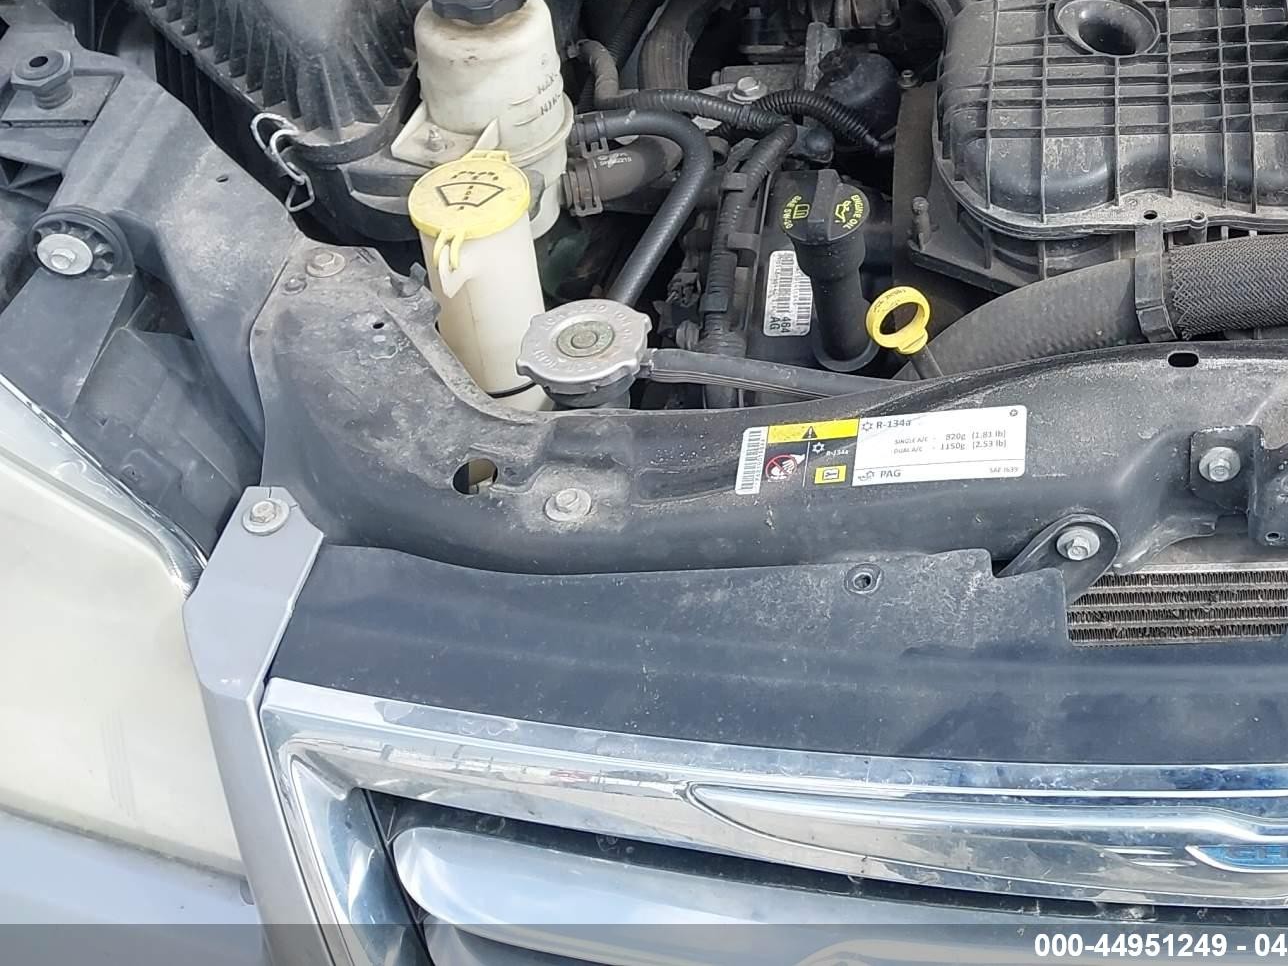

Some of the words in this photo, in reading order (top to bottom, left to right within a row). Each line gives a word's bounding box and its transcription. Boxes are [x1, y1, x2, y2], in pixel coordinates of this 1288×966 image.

[851, 194, 865, 219] ENGINE
[842, 218, 858, 230] OIL
[769, 316, 781, 331] AG
[781, 316, 792, 333] 464
[876, 419, 912, 430] R-134a
[946, 431, 966, 442] 820g
[940, 442, 966, 452] 1150g
[826, 449, 849, 457] R-134a
[880, 468, 902, 478] PAG
